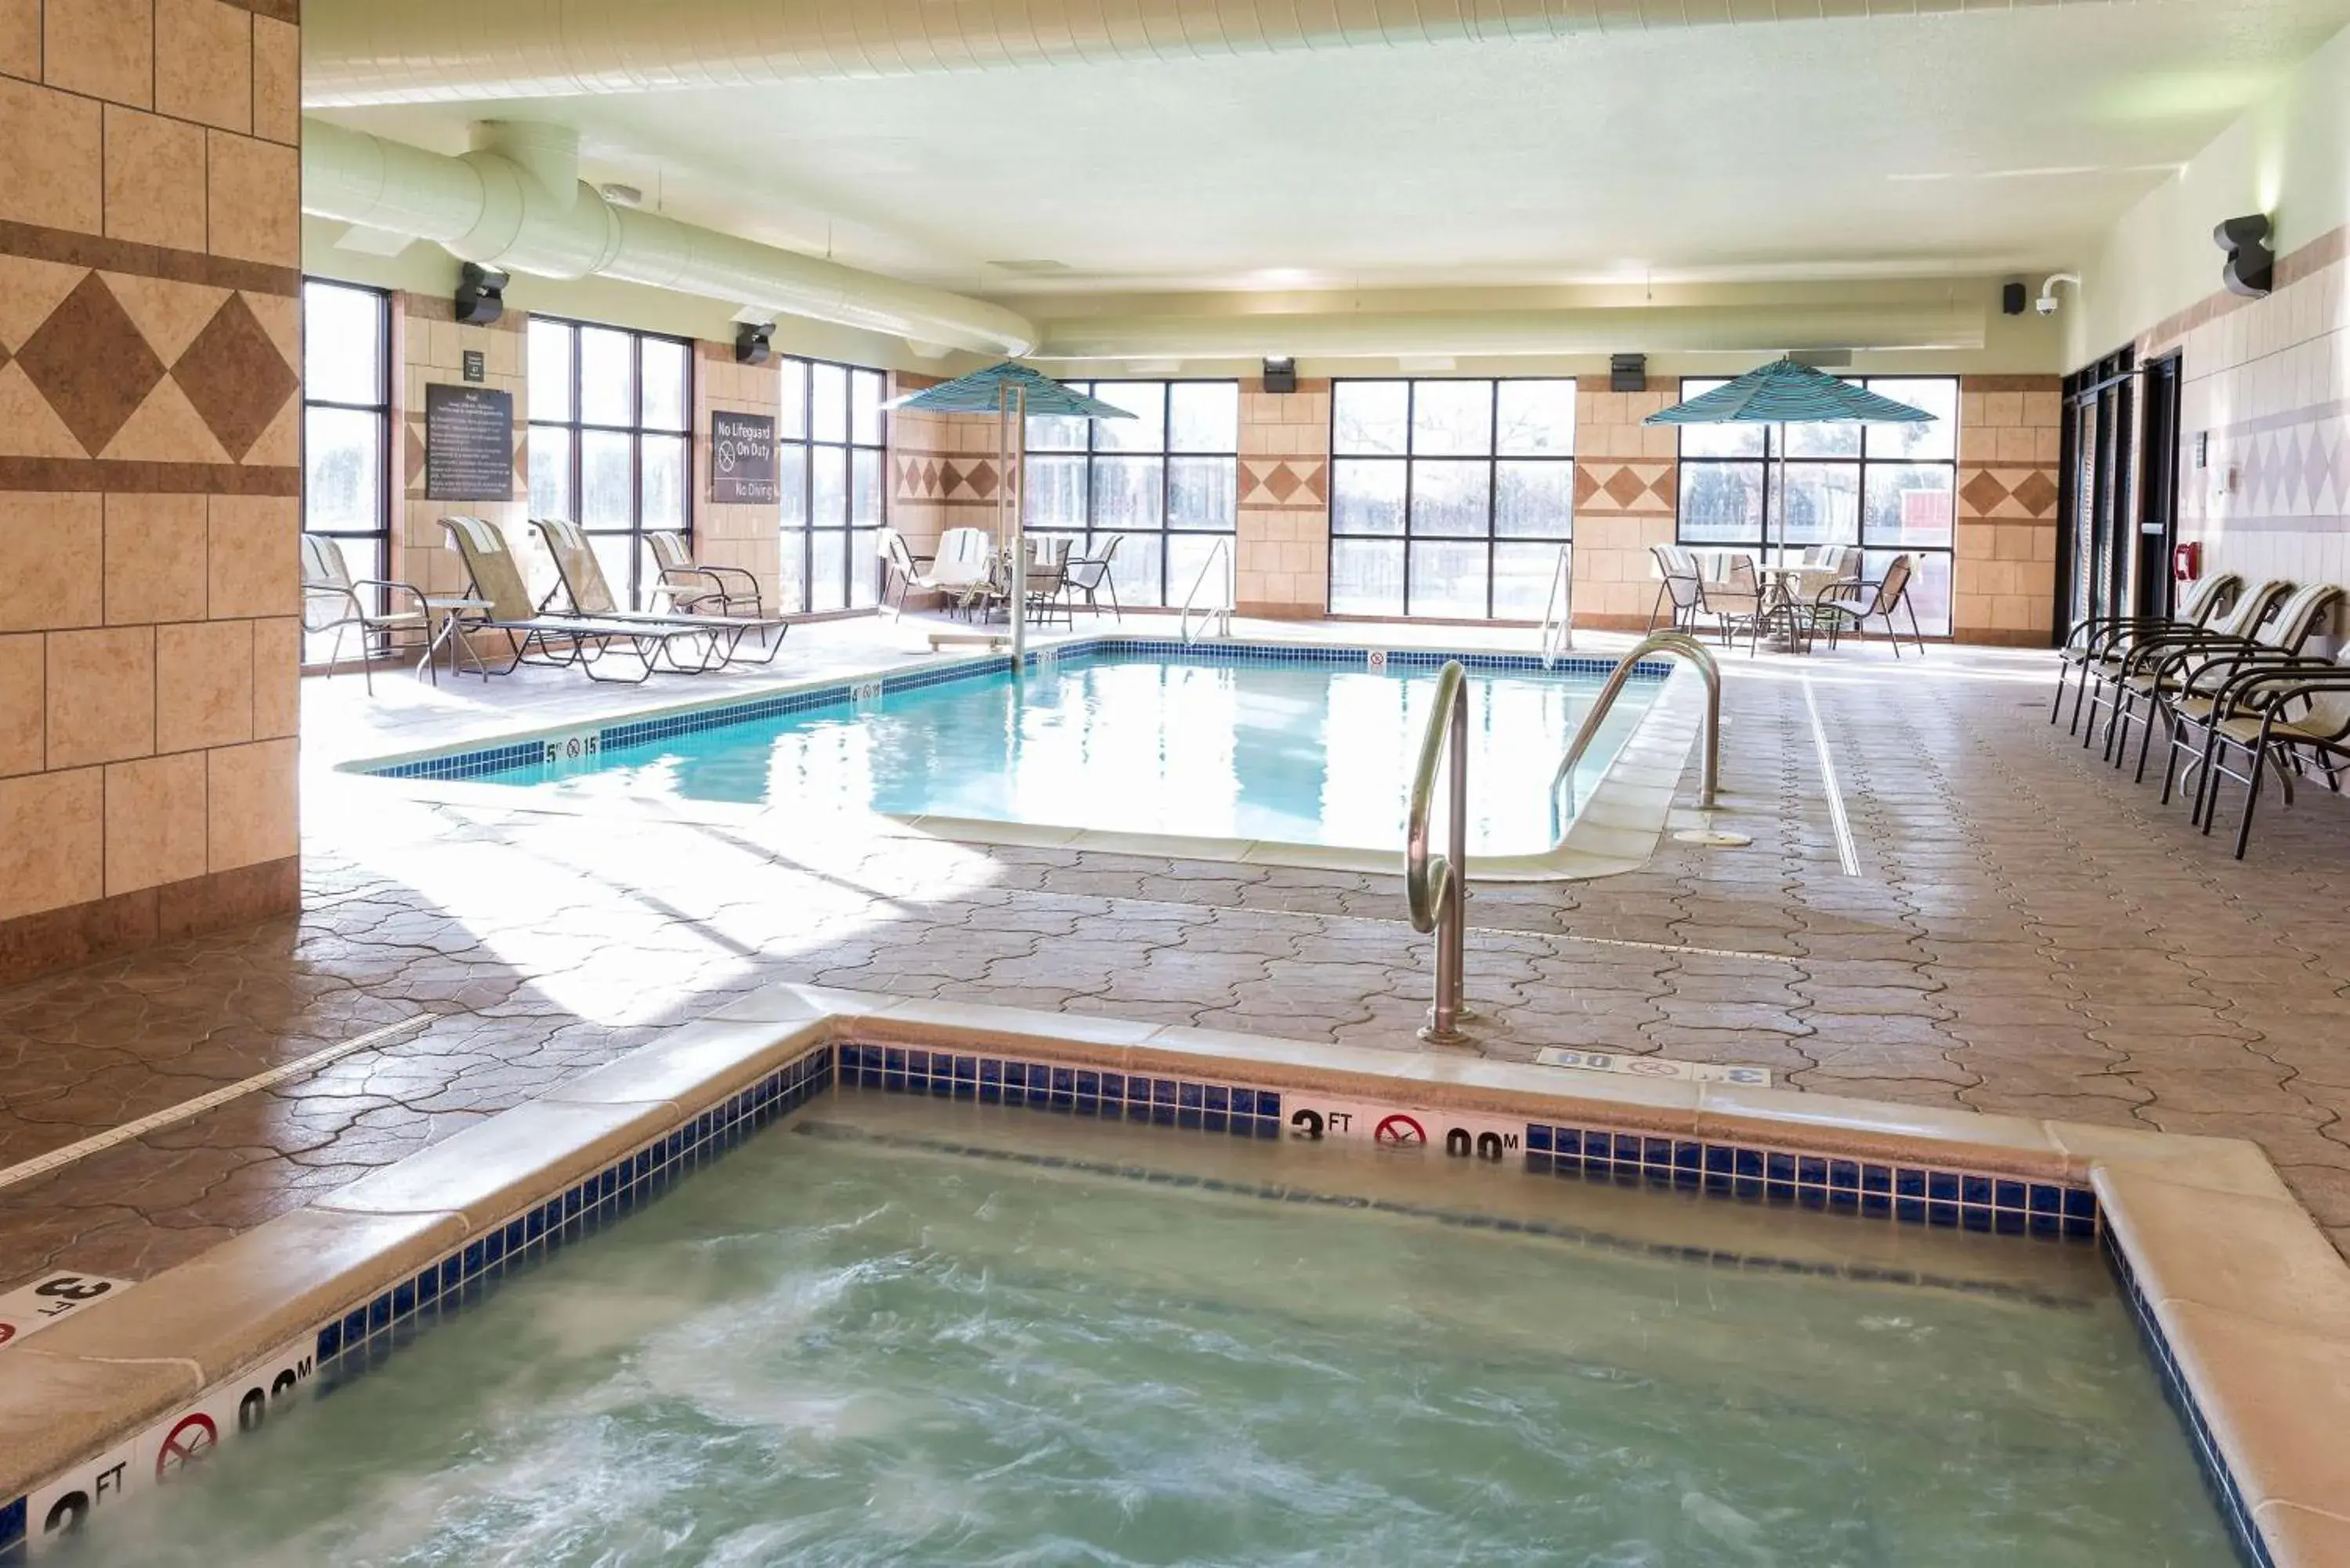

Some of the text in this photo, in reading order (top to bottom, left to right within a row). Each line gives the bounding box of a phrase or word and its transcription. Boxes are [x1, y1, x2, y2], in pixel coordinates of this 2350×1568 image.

[718, 421, 770, 441] No Lifeguard
[737, 442, 769, 461] On Duty
[736, 482, 772, 500] No Diving
[547, 743, 555, 763] 5
[1329, 1112, 1353, 1133] FT
[35, 1277, 111, 1317] 3 FT
[96, 1461, 126, 1505] FT
